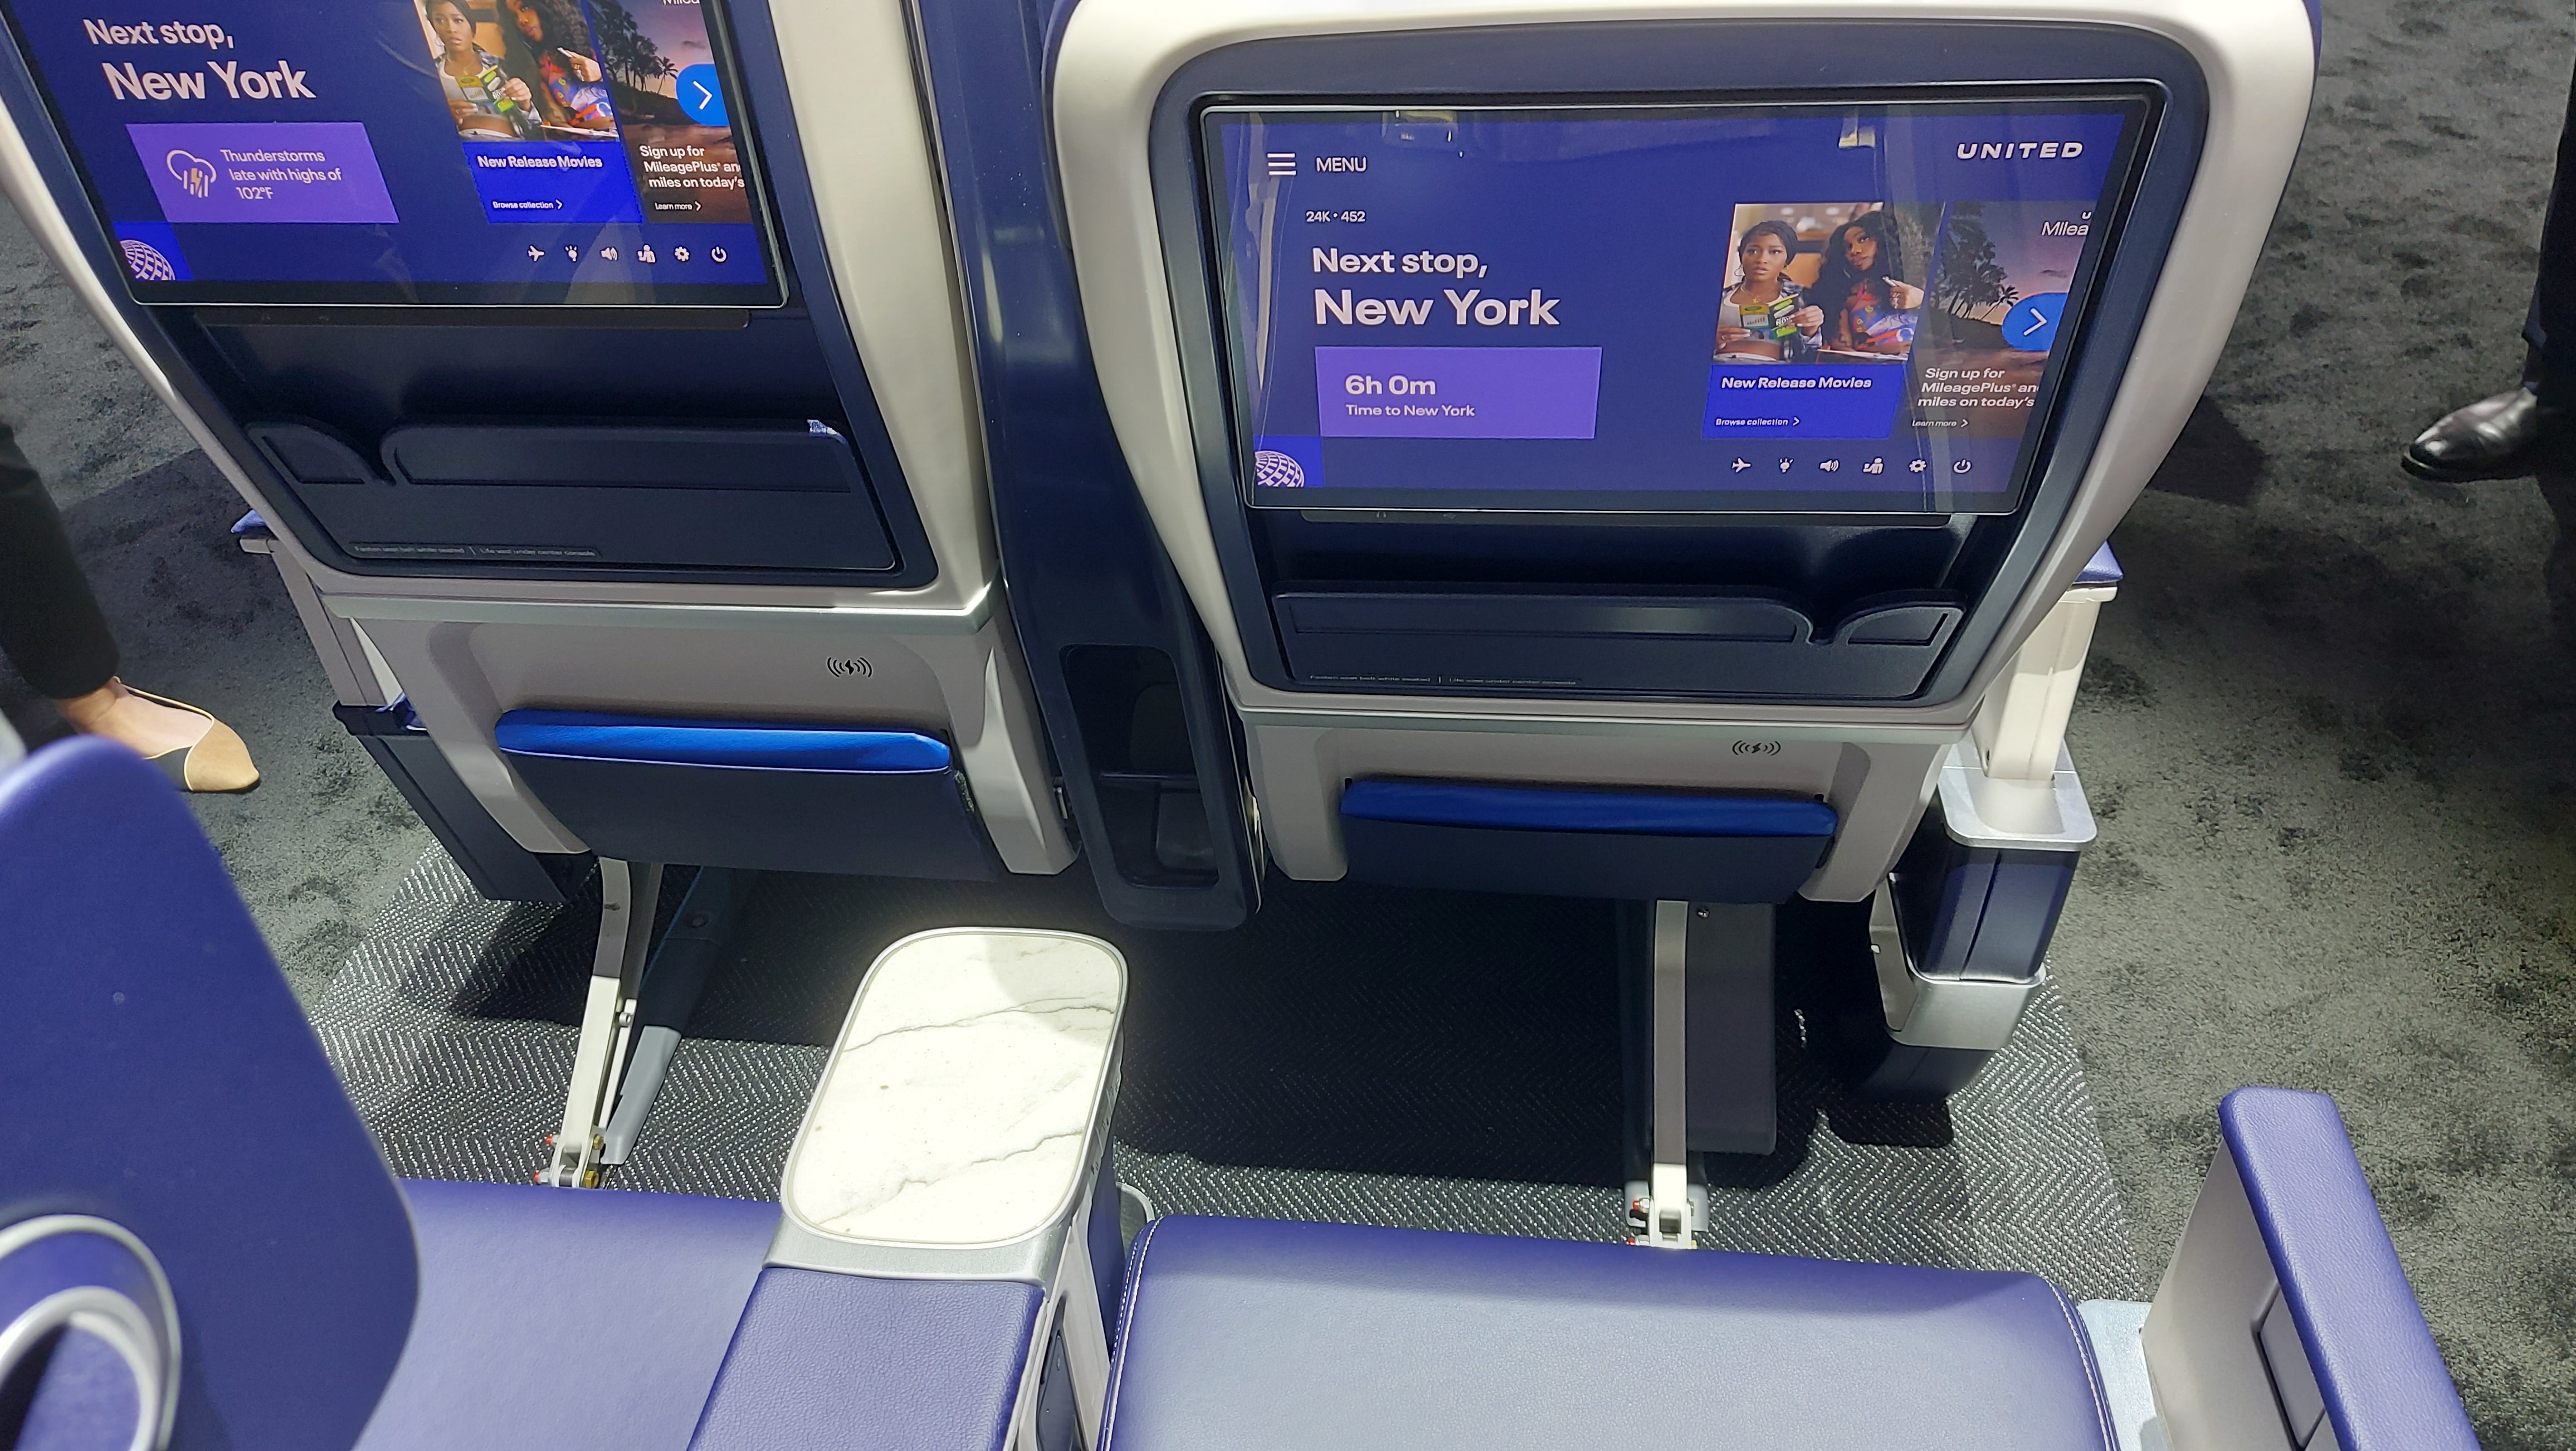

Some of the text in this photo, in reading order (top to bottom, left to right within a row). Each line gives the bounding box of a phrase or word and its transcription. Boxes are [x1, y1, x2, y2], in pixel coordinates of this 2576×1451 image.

[84, 19, 234, 50] Next stop,
[101, 60, 316, 100] New York
[220, 149, 325, 162] Thunderstorms
[640, 145, 705, 159] Sign up for
[1957, 142, 2083, 159] UNITED
[477, 155, 603, 167] New Release Movies
[1316, 157, 1367, 172] MENU
[228, 168, 341, 183] late with highs of
[648, 176, 681, 188] miles
[683, 179, 699, 188] on
[655, 202, 674, 210] Learn
[1306, 211, 1331, 222] 24K
[1340, 211, 1365, 222] 452
[1313, 247, 1487, 279] Next stop,
[1315, 288, 1560, 326] New York
[1925, 368, 2006, 381] Sign up for
[1345, 374, 1382, 395] 6h
[1721, 377, 1872, 388] New Release Movies
[1918, 397, 1957, 407] miles
[1959, 398, 1978, 407] on
[1346, 404, 1475, 416] Time to New York
